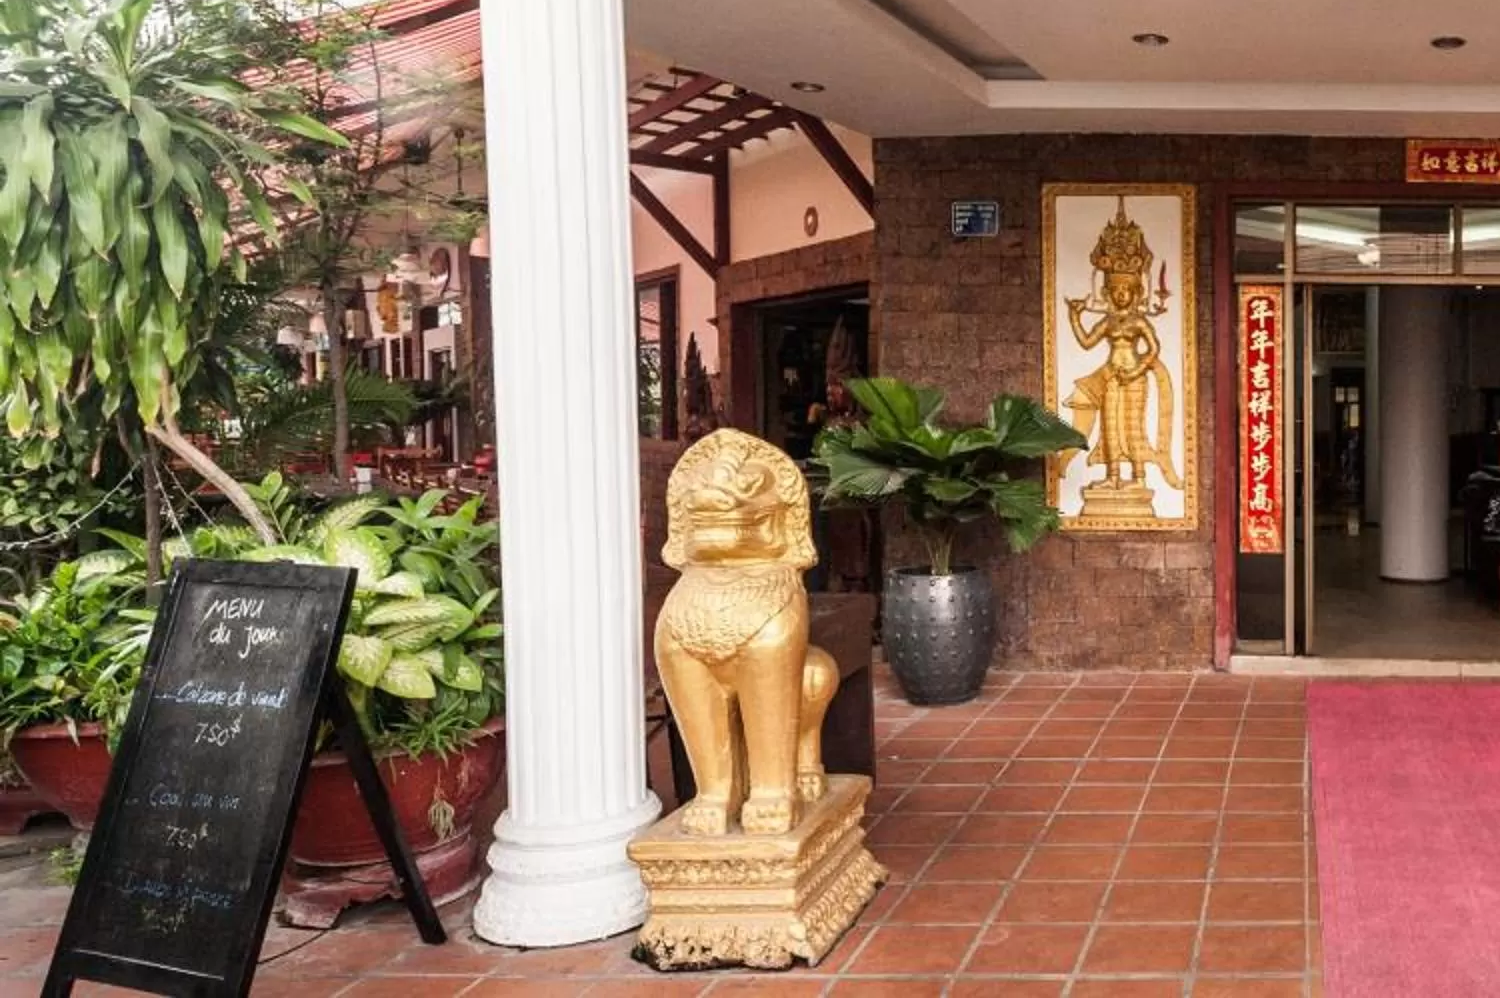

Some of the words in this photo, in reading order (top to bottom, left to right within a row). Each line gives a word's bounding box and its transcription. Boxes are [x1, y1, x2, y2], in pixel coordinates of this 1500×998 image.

[1247, 298, 1275, 513] 年年吉祥步步高
